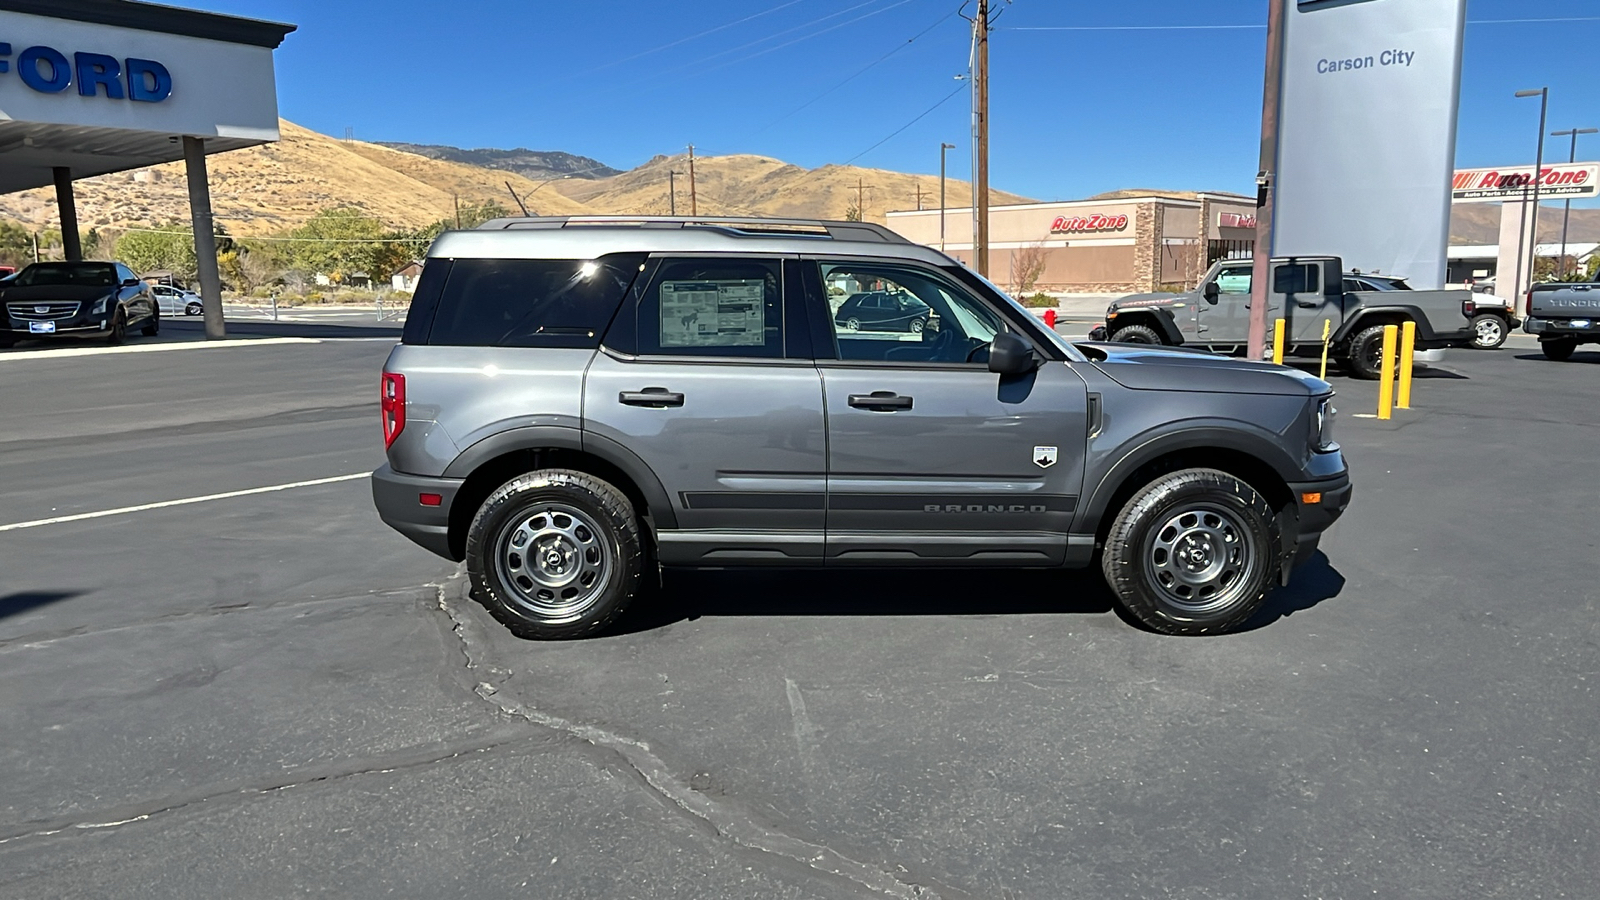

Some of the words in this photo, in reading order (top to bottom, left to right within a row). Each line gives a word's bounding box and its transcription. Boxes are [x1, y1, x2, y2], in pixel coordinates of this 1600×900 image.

[1317, 56, 1374, 74] Carson
[1380, 49, 1415, 67] City
[0, 42, 172, 103] ORD
[1478, 167, 1589, 189] AutoZone
[1051, 214, 1127, 231] AutoZone
[1549, 299, 1600, 307] TUNDR
[924, 505, 1046, 513] BRONCO
